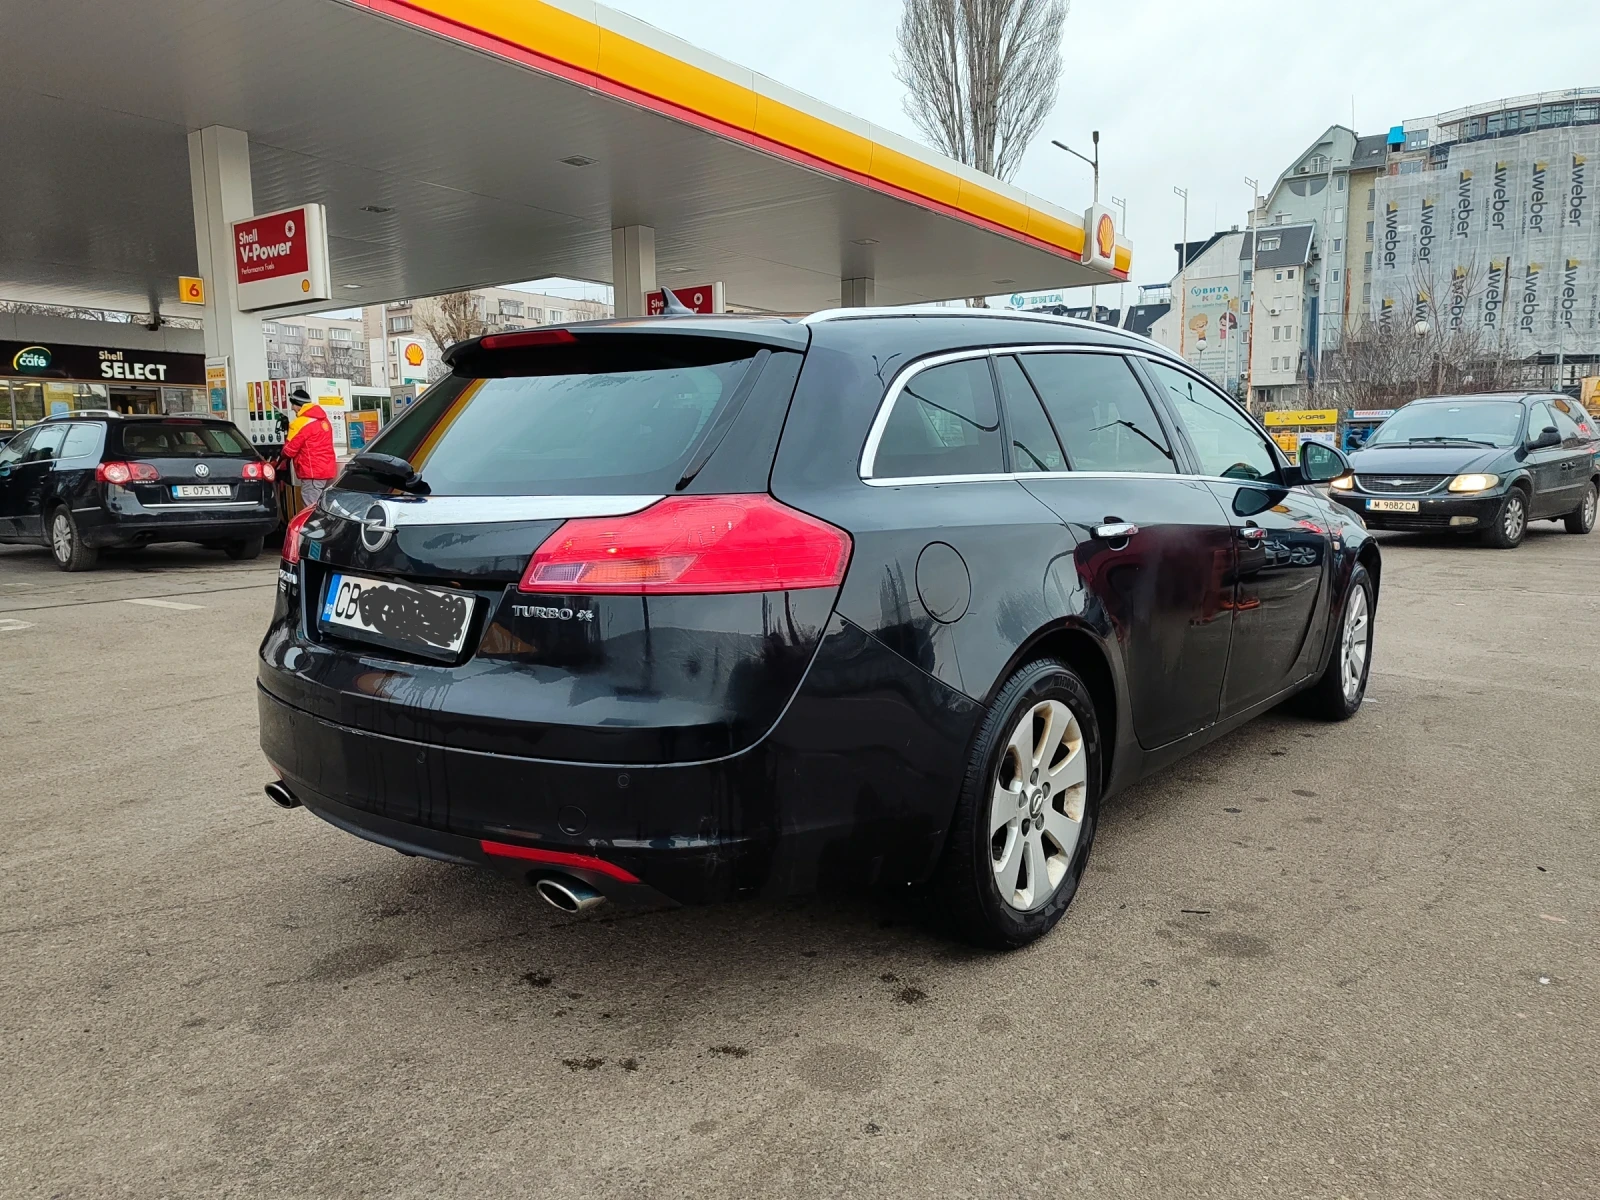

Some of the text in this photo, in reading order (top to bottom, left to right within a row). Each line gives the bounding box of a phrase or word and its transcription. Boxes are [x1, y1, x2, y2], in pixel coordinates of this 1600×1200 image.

[1457, 183, 1474, 238] weber
[1492, 172, 1509, 230] weber
[1530, 174, 1548, 233] weber
[1569, 168, 1587, 227] weber
[239, 228, 258, 245] Shell
[240, 241, 292, 263] V-Power
[1384, 213, 1401, 269] weber
[1419, 210, 1436, 264] weber
[189, 283, 200, 297] 6
[651, 298, 664, 308] She
[1031, 294, 1063, 304] ВИТА
[1202, 286, 1229, 294] ВИТА
[1484, 273, 1502, 330] weber
[1520, 276, 1540, 333] weber
[1559, 271, 1578, 329] weber
[98, 350, 123, 361] Shell
[100, 361, 167, 381] SELECT
[511, 605, 573, 620] TURBO
